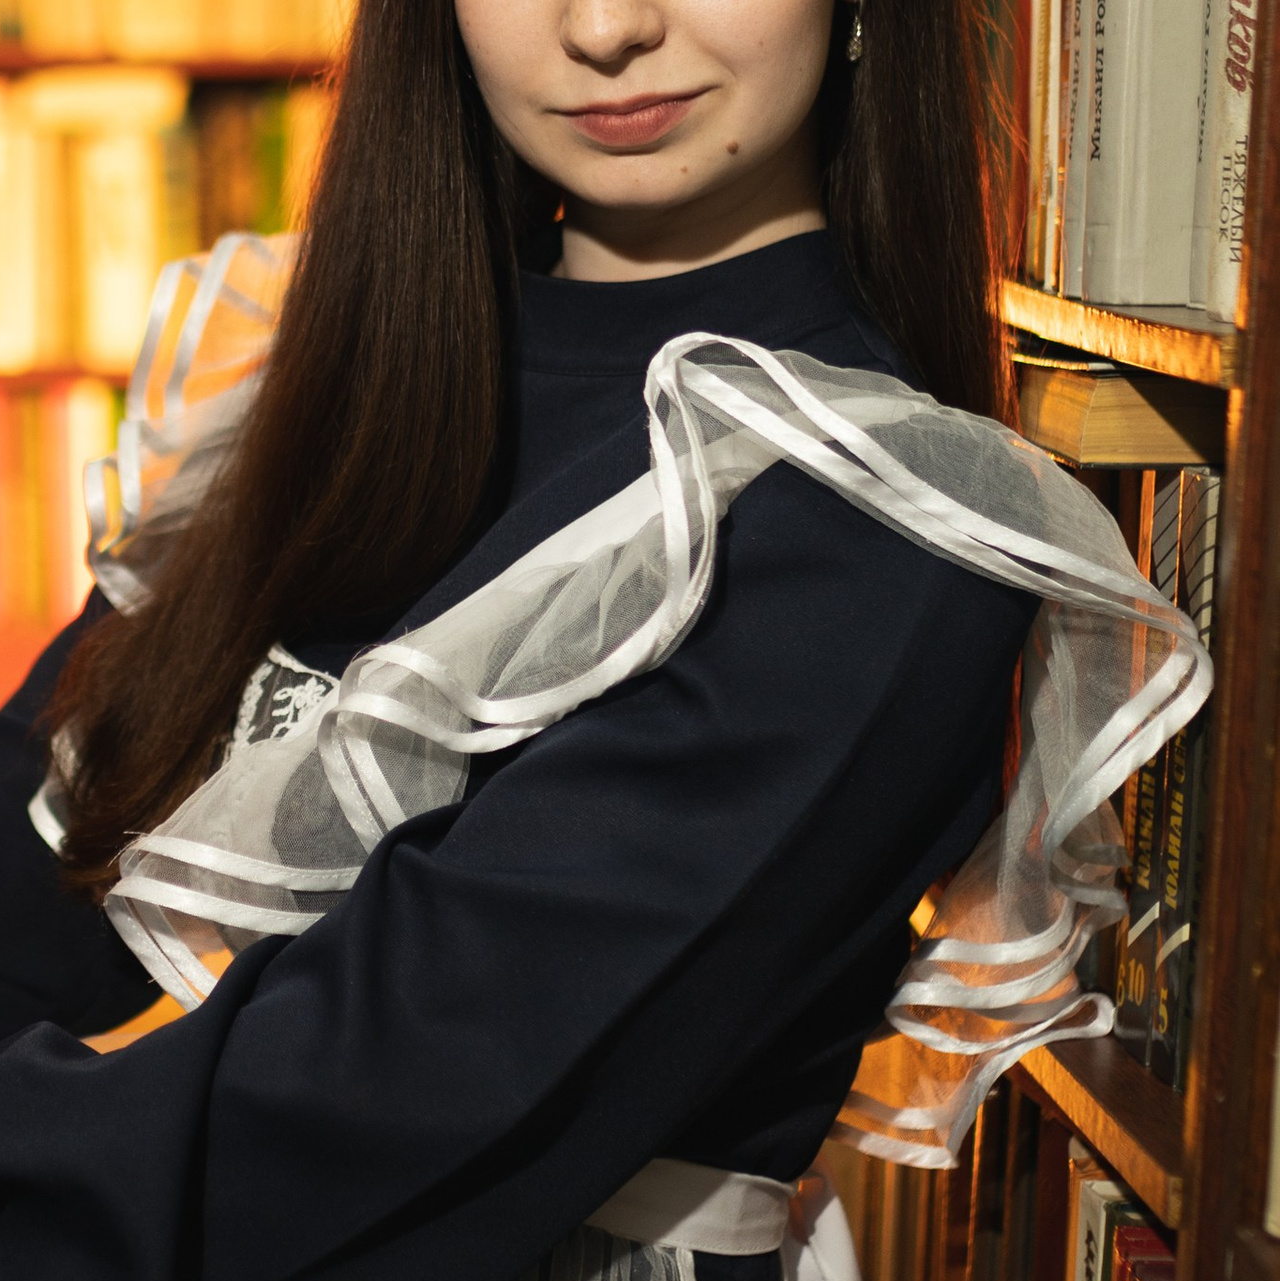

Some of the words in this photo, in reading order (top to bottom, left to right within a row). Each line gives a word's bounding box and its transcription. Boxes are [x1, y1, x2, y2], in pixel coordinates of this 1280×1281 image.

[1089, 46, 1106, 162] Михаил
[1218, 154, 1233, 243] ПЕСОК
[1136, 773, 1157, 889] ЮЛИАН
[1164, 790, 1185, 911] ЮЛИАН
[1128, 957, 1146, 1007] 10
[1158, 986, 1169, 1035] 5
